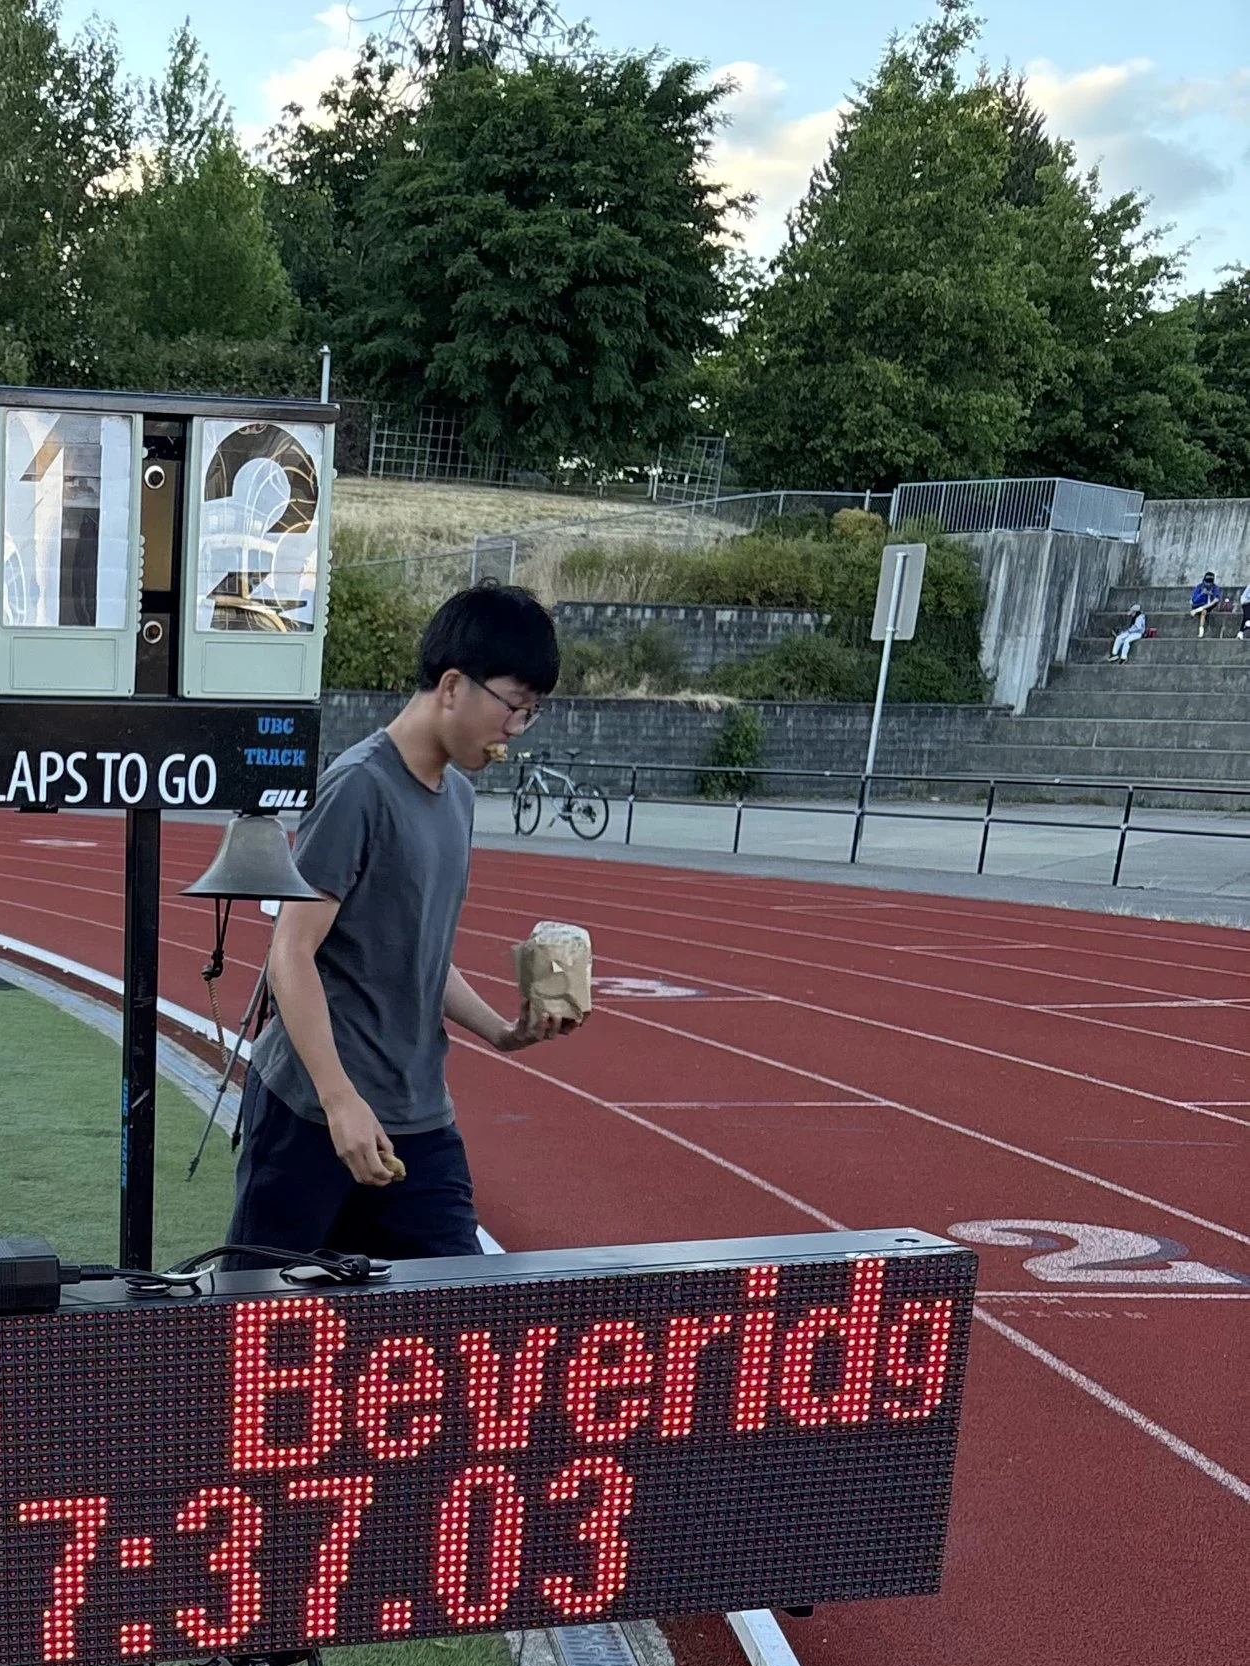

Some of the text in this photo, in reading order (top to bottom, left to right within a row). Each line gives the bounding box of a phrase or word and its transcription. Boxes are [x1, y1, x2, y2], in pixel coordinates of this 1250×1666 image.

[257, 716, 295, 736] UBC
[244, 747, 306, 767] TRACK
[96, 751, 148, 805] TO
[157, 752, 218, 806] GO
[258, 788, 308, 809] GILL
[946, 1218, 1244, 1285] 2
[232, 1254, 953, 1471] Beveridg
